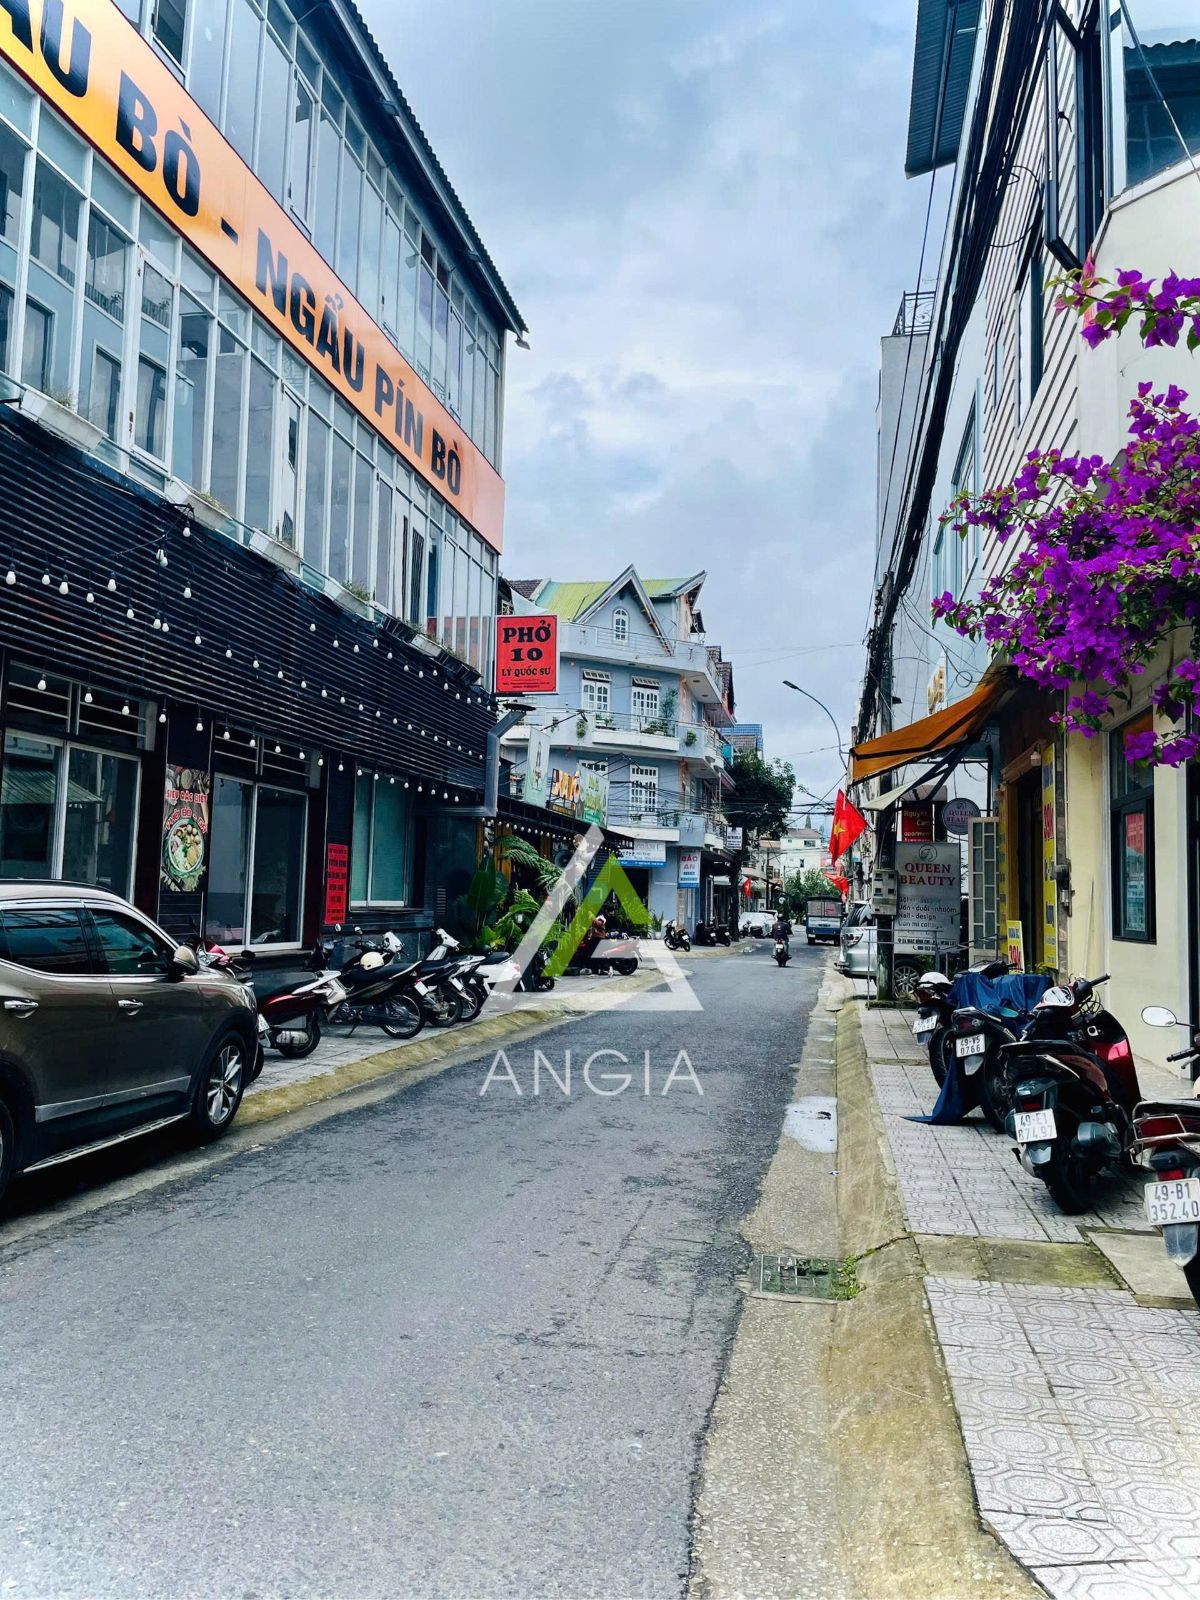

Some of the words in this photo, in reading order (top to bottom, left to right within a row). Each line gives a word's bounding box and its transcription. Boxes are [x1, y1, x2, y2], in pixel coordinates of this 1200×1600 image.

[116, 70, 200, 217] BÒ
[375, 363, 423, 459] PÍN
[431, 428, 461, 496] BÒ
[502, 620, 551, 643] PHỞ
[511, 647, 543, 661] 10
[514, 665, 537, 677] QUỐC
[905, 863, 951, 873] QUEEN
[900, 875, 955, 886] BEAUTY
[961, 1046, 980, 1055] 0766
[1155, 1182, 1191, 1201] 49-B1
[1151, 1200, 1199, 1221] 352.40
